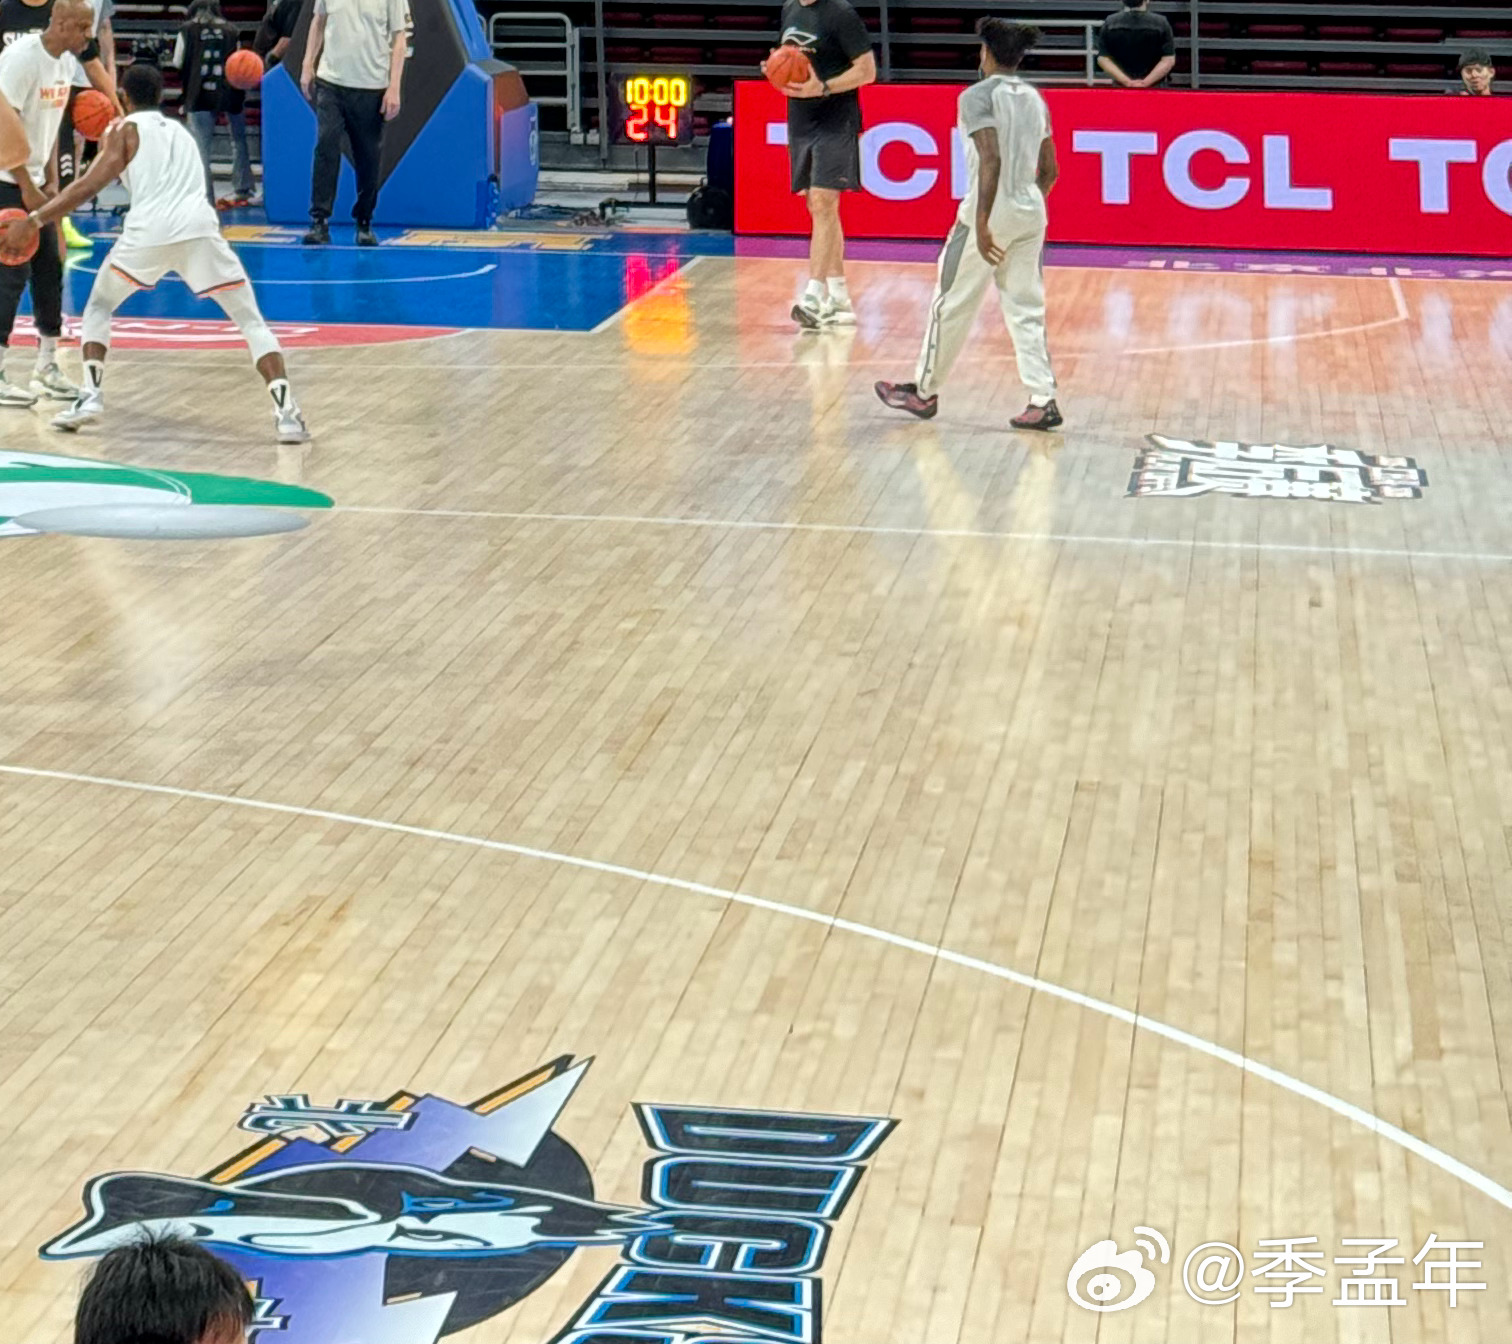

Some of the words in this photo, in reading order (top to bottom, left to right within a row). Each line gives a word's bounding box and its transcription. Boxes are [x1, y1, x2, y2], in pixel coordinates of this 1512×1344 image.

[626, 78, 687, 106] 10:00
[626, 104, 677, 141] 24
[1072, 129, 1333, 211] TCL
[550, 1102, 901, 1344] DUCK
